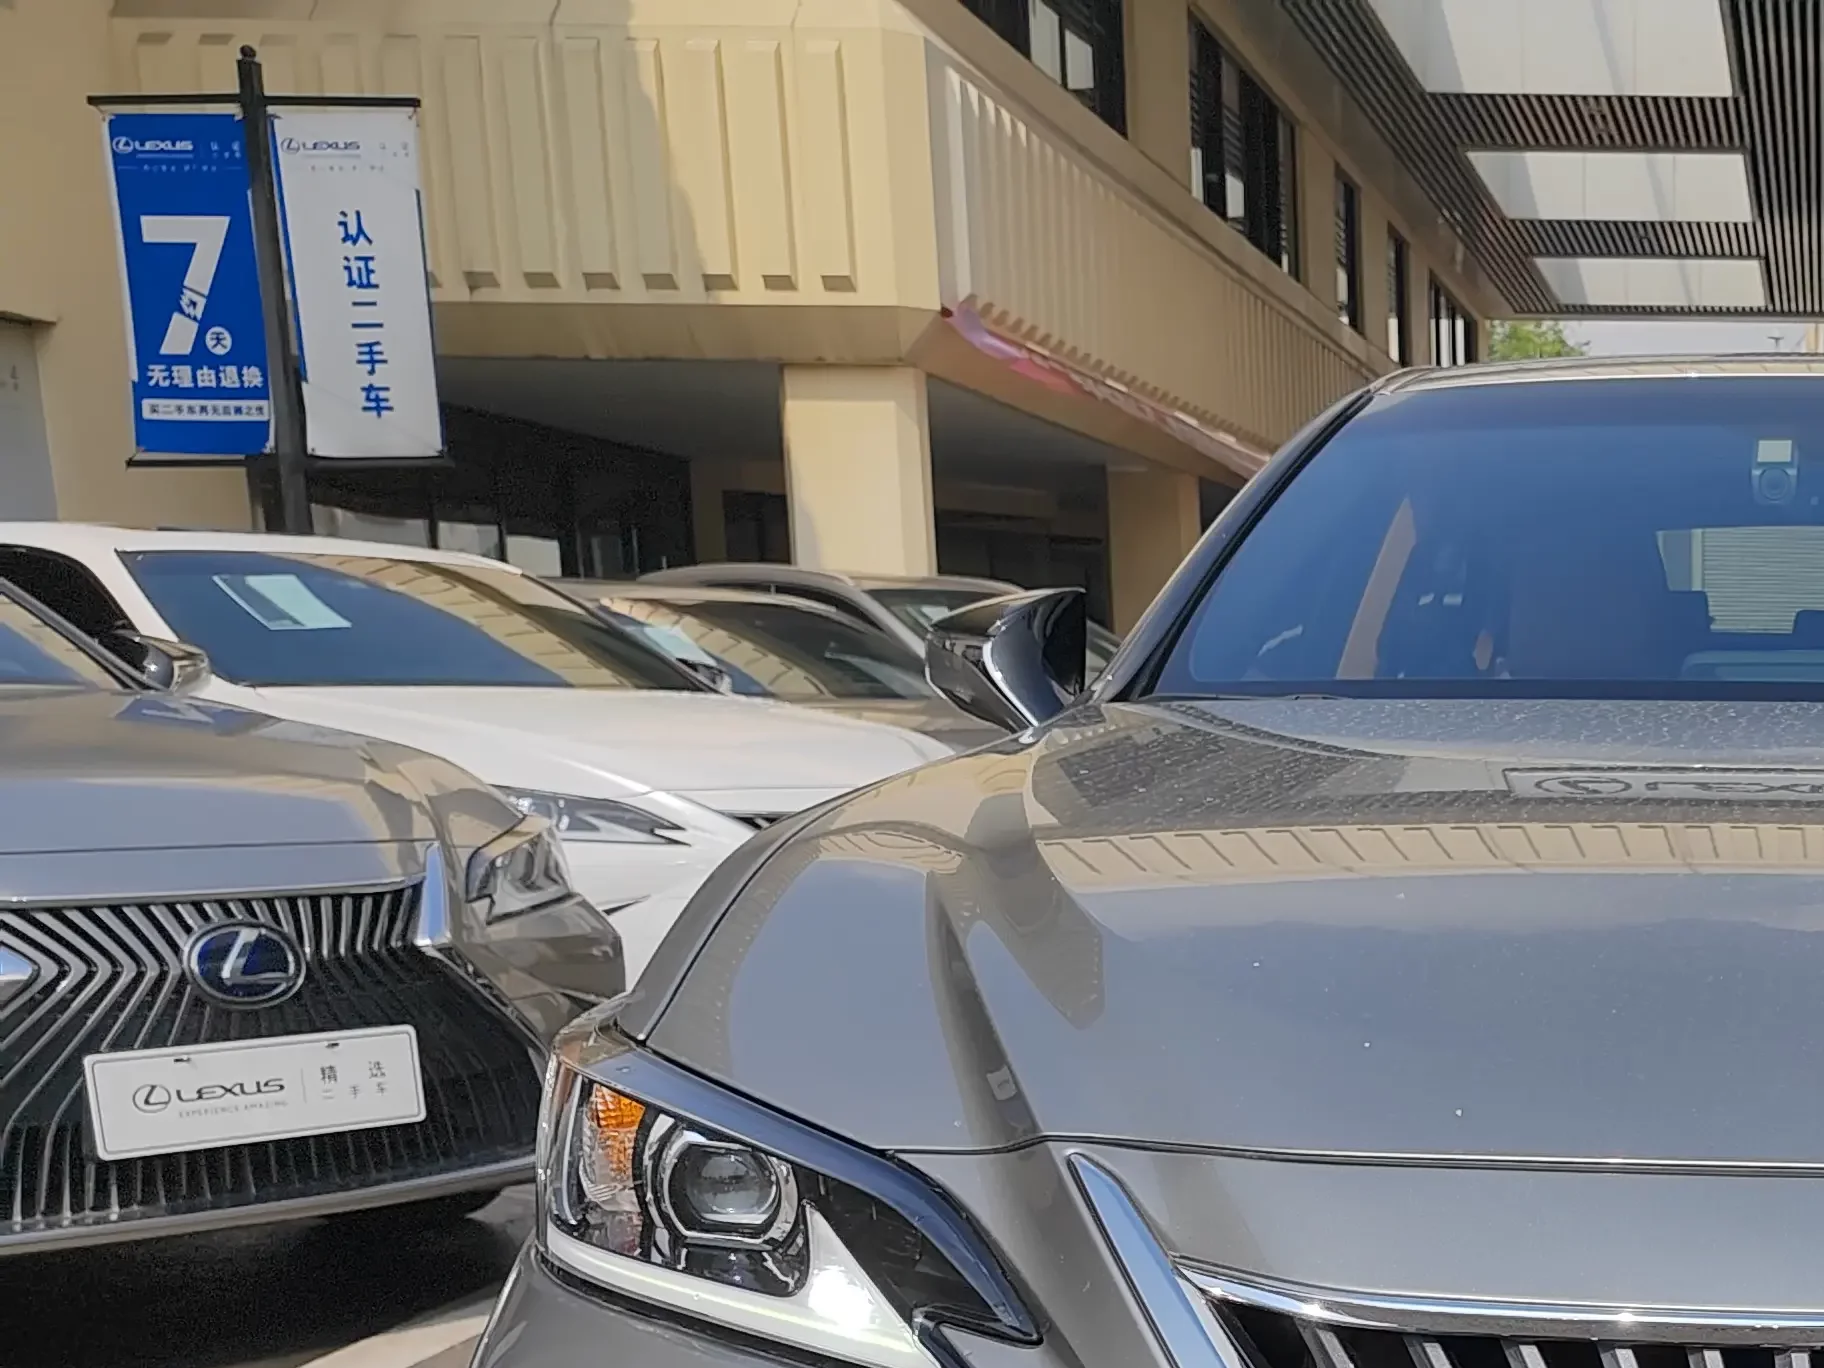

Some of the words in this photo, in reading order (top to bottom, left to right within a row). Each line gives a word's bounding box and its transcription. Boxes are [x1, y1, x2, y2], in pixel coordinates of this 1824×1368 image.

[134, 140, 194, 151] LEXUS
[302, 141, 361, 151] LEXUS
[337, 209, 395, 419] 认证二手车
[146, 364, 264, 388] 无理由退换
[320, 1060, 387, 1085] 精选
[176, 1078, 286, 1103] LEXUS
[322, 1081, 389, 1099] 二手车
